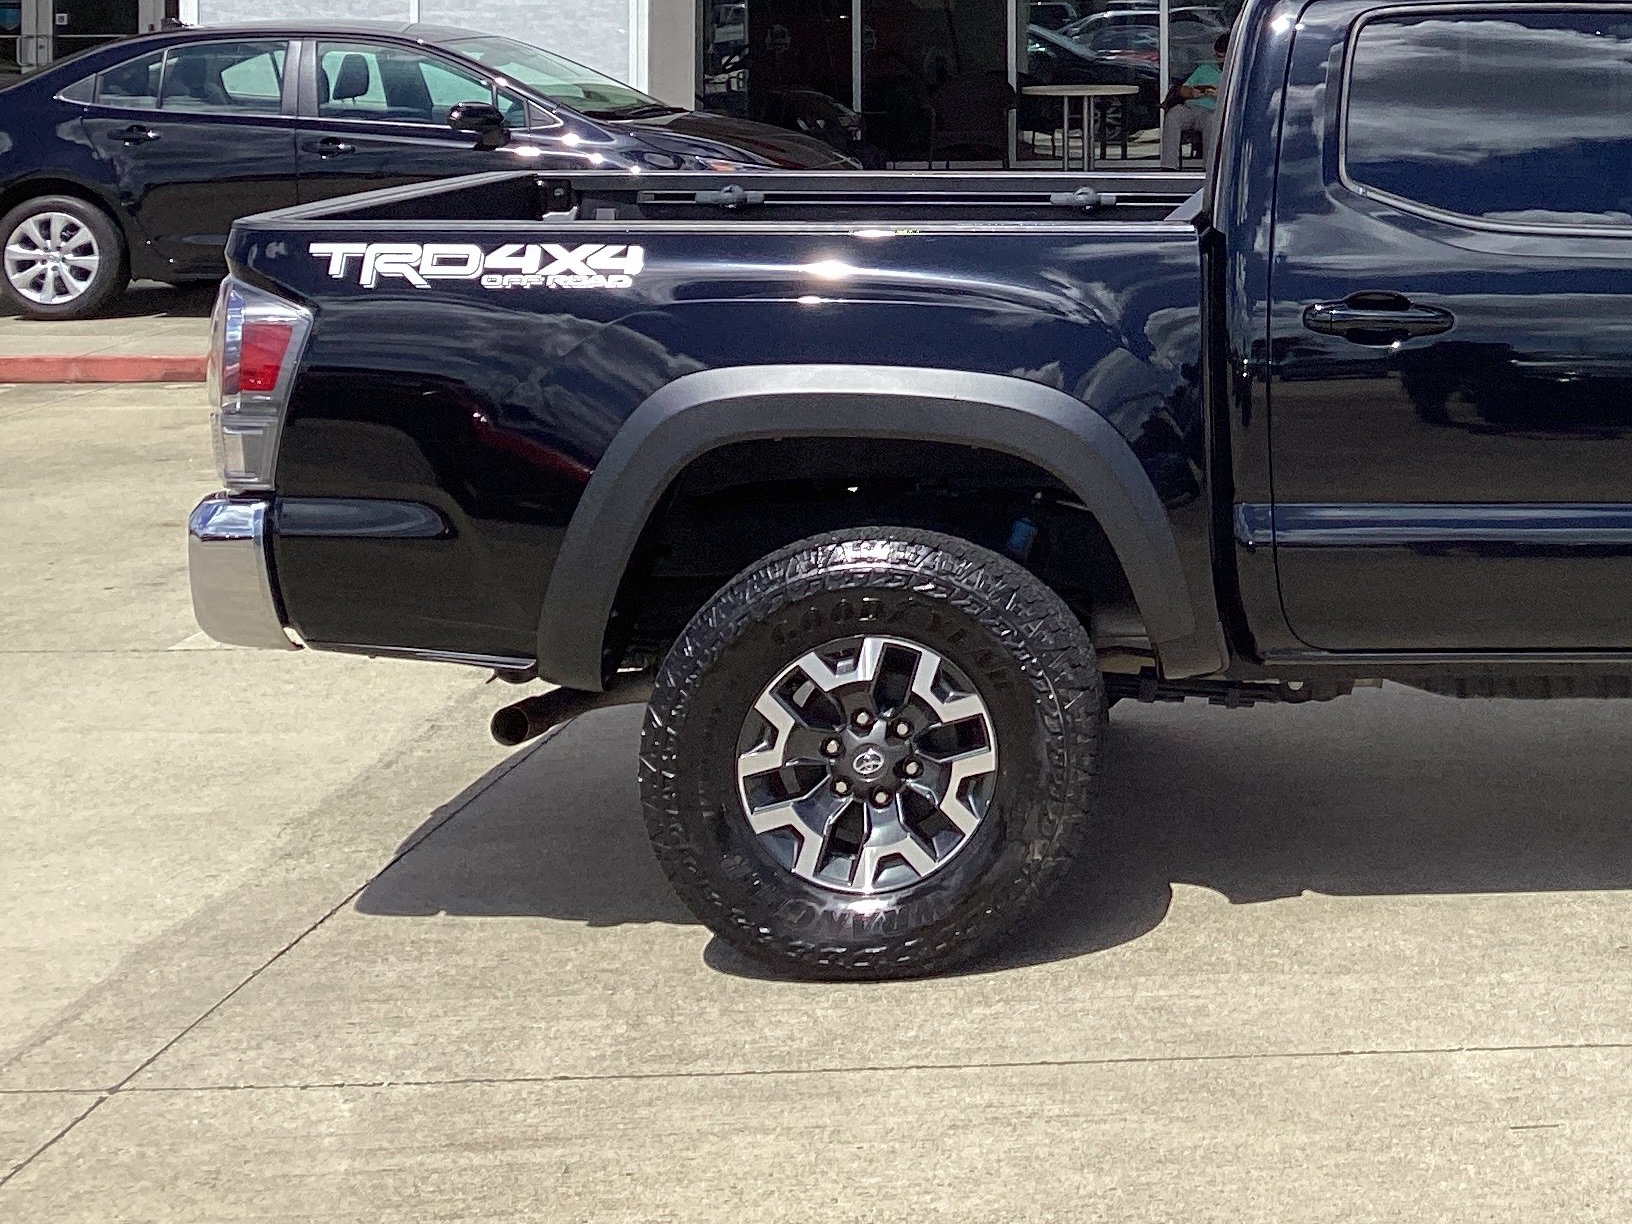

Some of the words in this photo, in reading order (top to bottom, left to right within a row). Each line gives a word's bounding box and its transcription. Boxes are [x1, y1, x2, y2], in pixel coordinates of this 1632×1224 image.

[309, 243, 484, 289] TRD
[481, 275, 546, 289] OFF
[546, 275, 635, 289] ROAD
